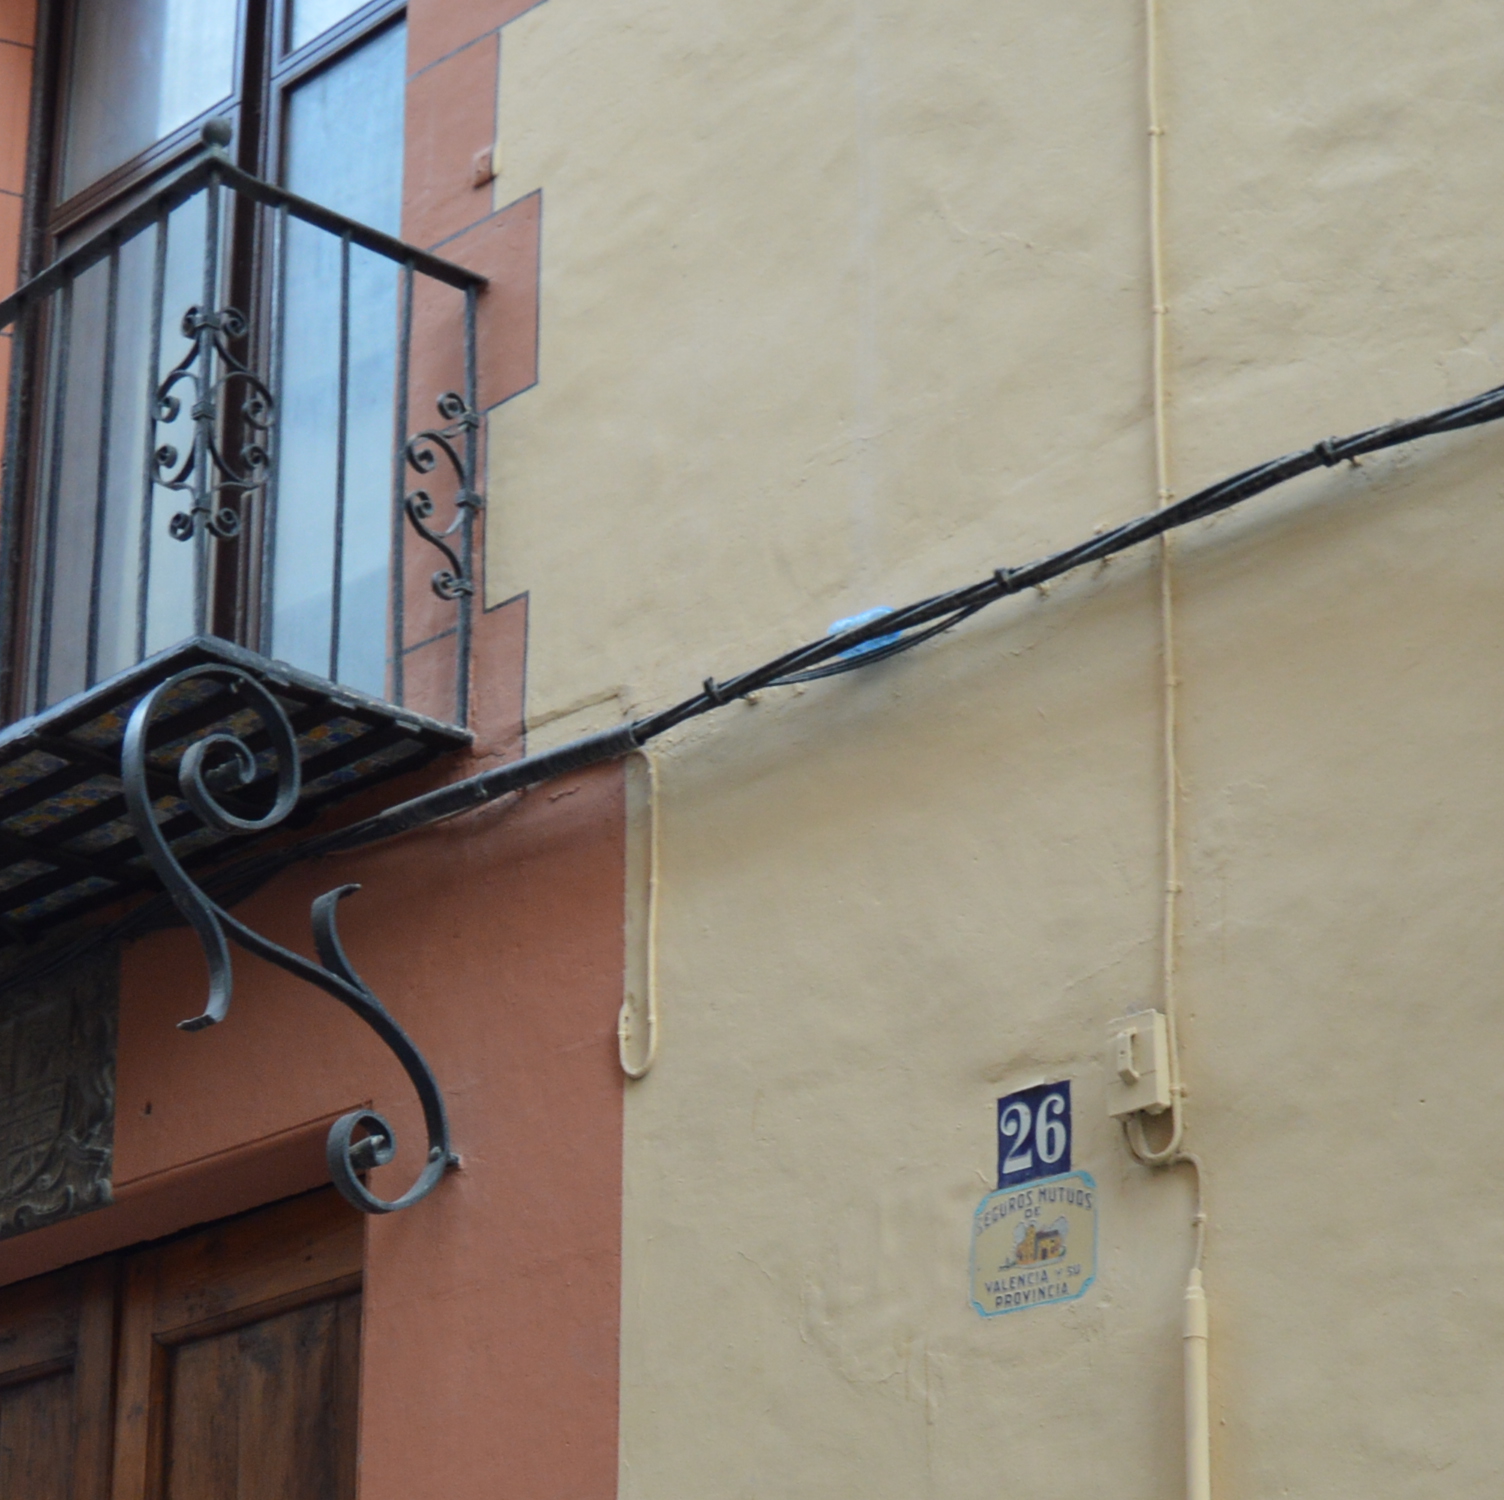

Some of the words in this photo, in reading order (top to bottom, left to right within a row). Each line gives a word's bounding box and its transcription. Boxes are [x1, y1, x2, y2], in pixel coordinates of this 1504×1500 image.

[999, 1093, 1067, 1174] 26
[975, 1190, 1033, 1237] SEGUROS
[1038, 1186, 1093, 1210] MUTUOS
[1024, 1206, 1041, 1219] DE
[985, 1269, 1049, 1294] VALENCIA
[1067, 1263, 1081, 1276] SU
[995, 1281, 1069, 1308] PROVINCIA
